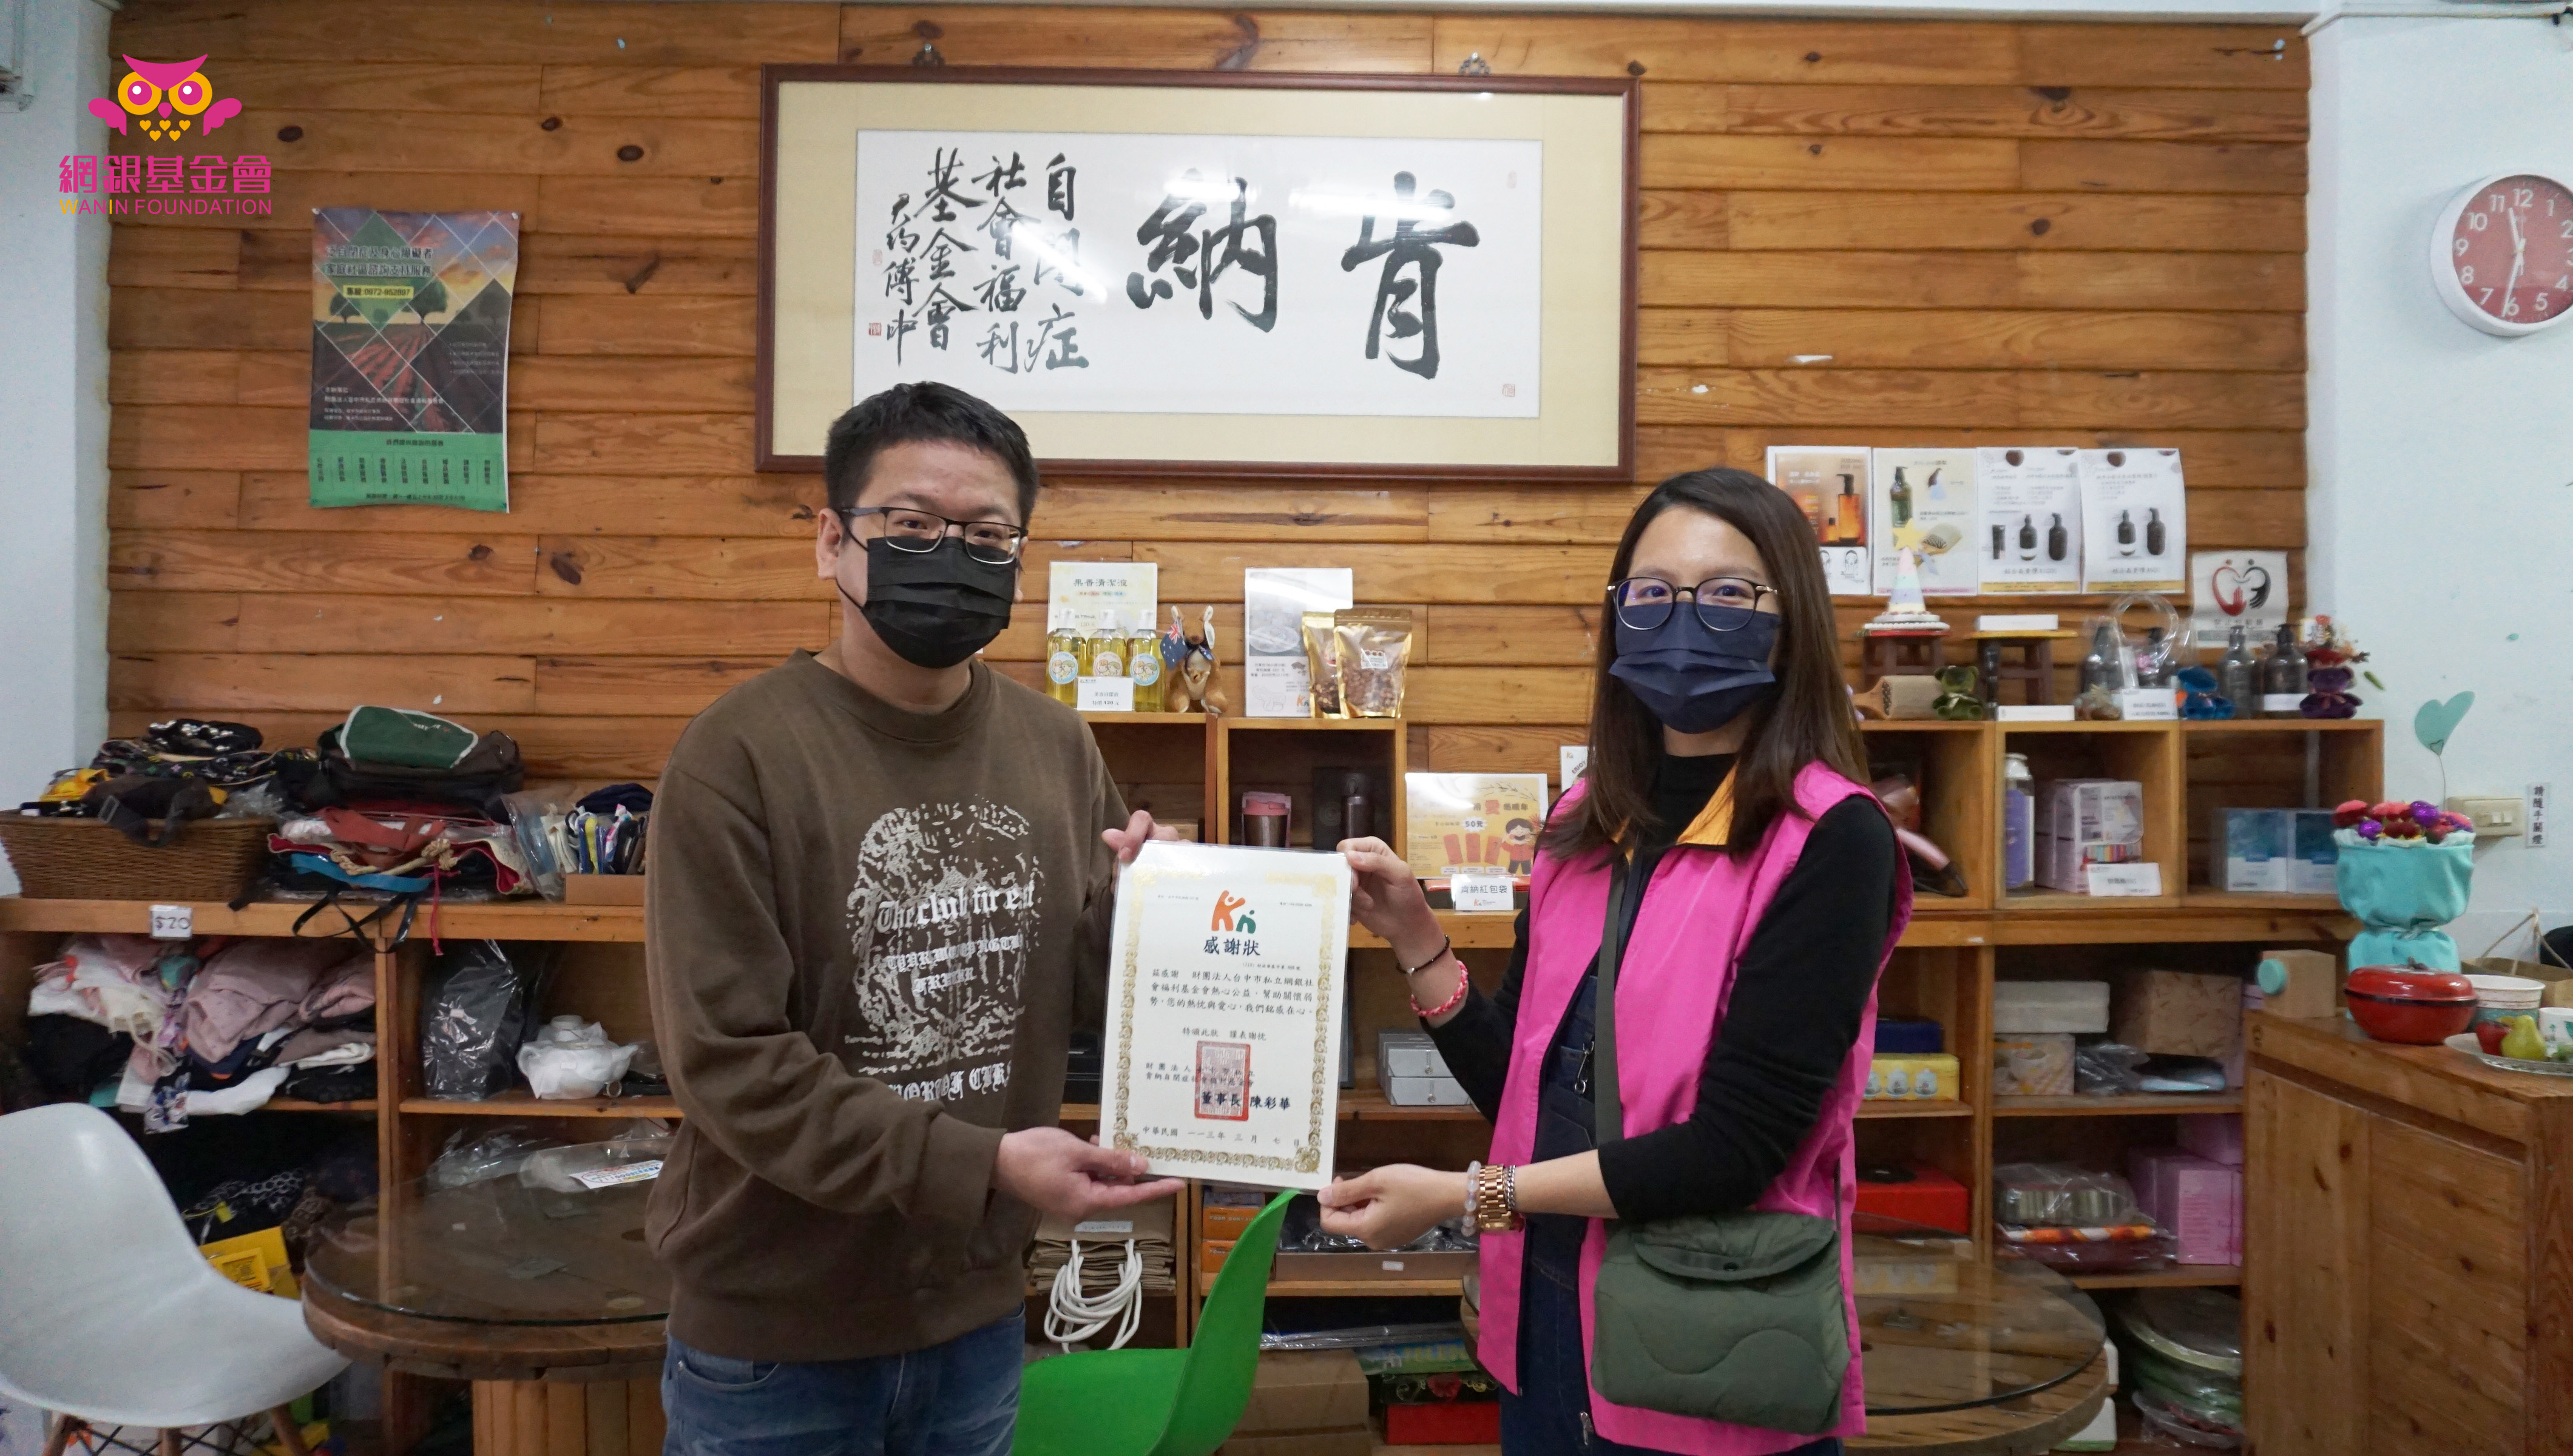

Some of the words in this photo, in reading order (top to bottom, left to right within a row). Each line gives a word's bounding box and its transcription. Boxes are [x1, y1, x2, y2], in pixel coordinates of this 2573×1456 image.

[2490, 194, 2505, 212] 11
[2512, 187, 2534, 207] 12
[2548, 199, 2555, 216] 1
[2468, 212, 2488, 231] 10
[910, 146, 988, 351] 基金會
[2455, 238, 2469, 257] 9
[970, 151, 1041, 374] 社會福利
[2461, 265, 2475, 285] 8
[2555, 274, 2569, 292] 4
[2480, 287, 2494, 305] 7
[2534, 292, 2548, 311] 5
[2506, 297, 2520, 317] 6
[1073, 579, 1128, 587] 果香清潔液
[2532, 784, 2545, 844] 請隨手關燈
[1461, 885, 1507, 894] 肯納紅包袋
[1203, 936, 1261, 957] 感謝狀
[1152, 969, 1179, 979] 茲感謝
[1202, 1092, 1241, 1107] 董事長
[1249, 1094, 1291, 1111] 陳彩華
[1143, 1126, 1178, 1138] 中華民國
